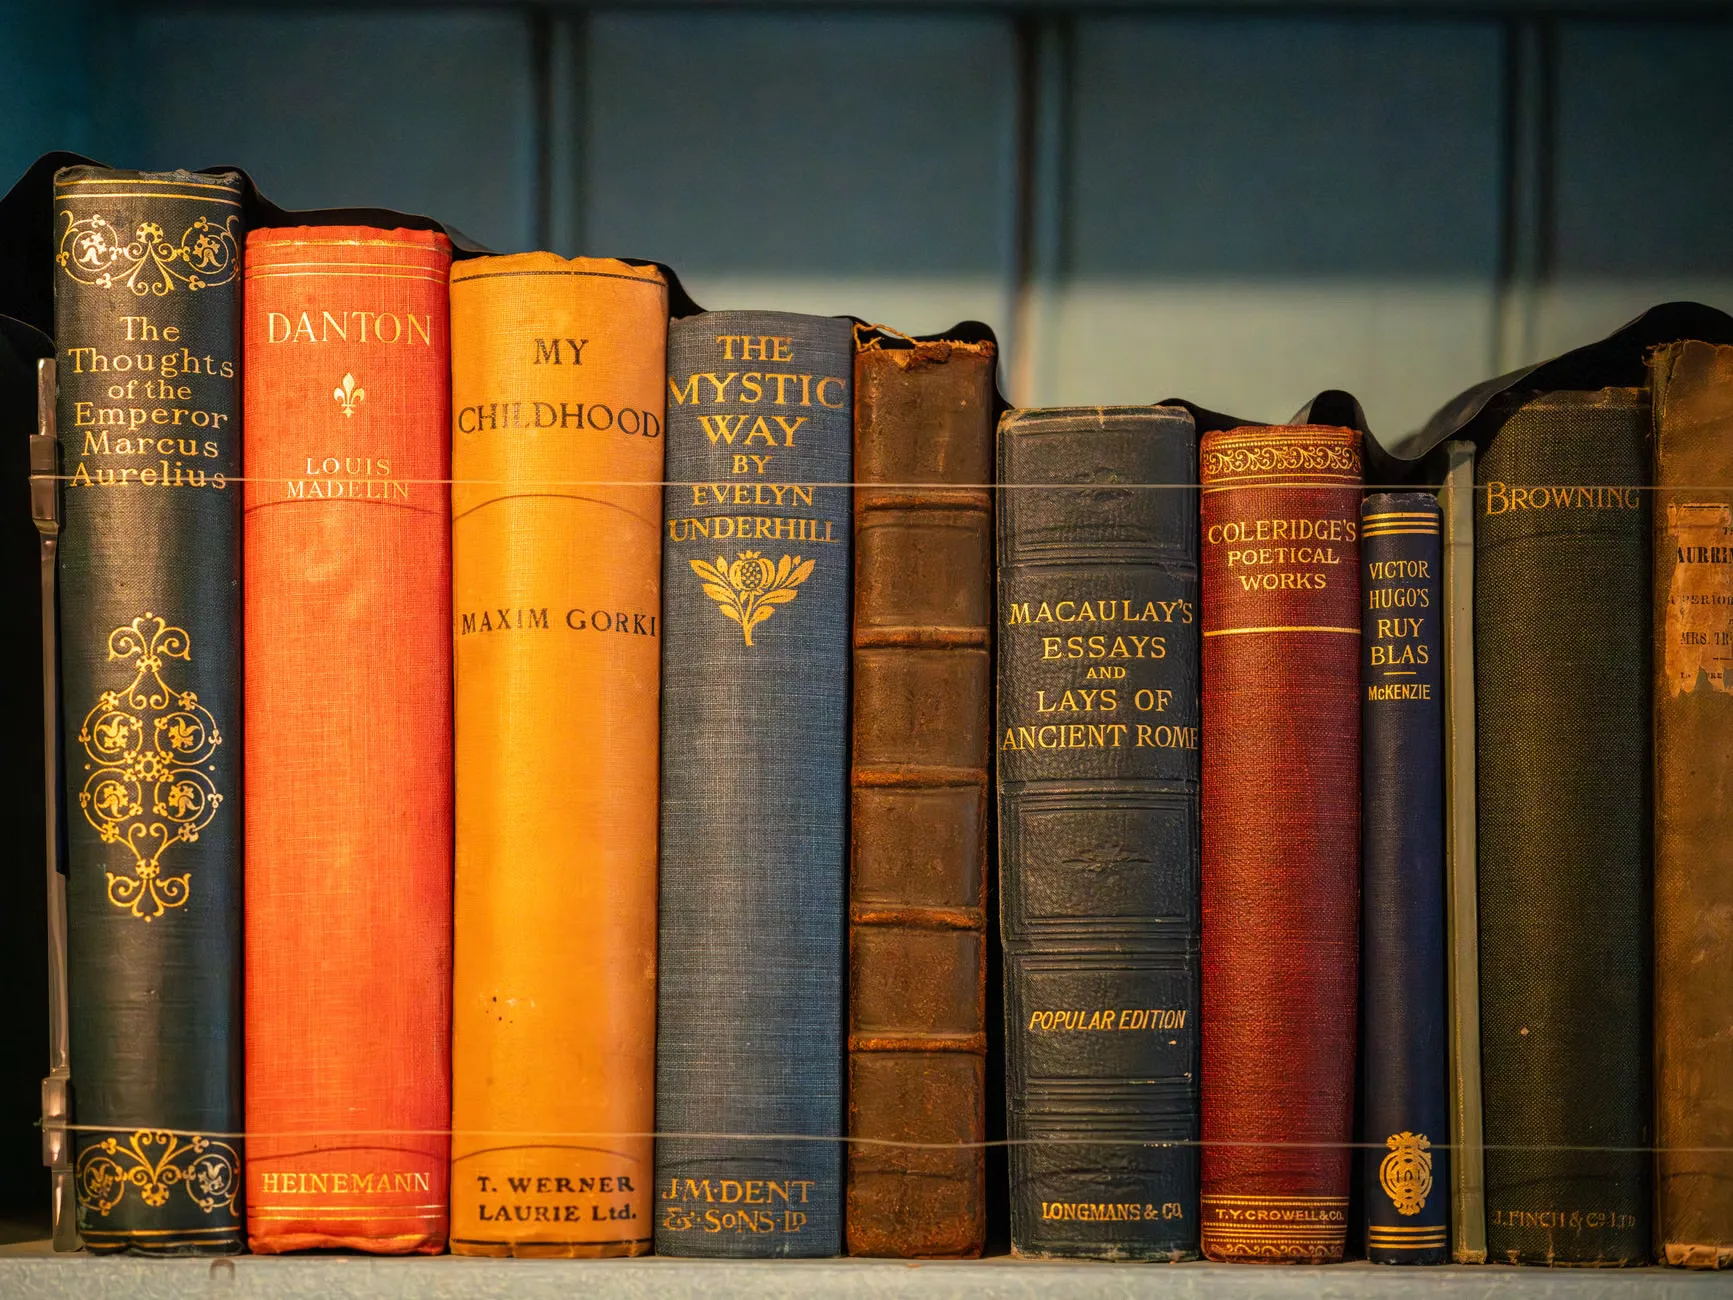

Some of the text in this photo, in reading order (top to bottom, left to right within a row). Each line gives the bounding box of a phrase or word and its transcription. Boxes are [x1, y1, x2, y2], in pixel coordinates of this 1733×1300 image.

[120, 316, 180, 342] The
[267, 311, 432, 346] DANTON
[533, 338, 589, 366] MY
[716, 336, 793, 362] THE
[68, 348, 234, 378] Thoughts
[108, 380, 192, 400] of the
[667, 371, 847, 408] MYSTIC
[74, 402, 228, 430] Emperor
[458, 402, 660, 438] CHILDHOOD
[696, 415, 808, 447] WAY
[82, 430, 219, 458] Marcus
[70, 460, 227, 489] Aurelius
[306, 458, 391, 475] LOUIS
[732, 454, 773, 474] BY
[287, 480, 409, 500] MADELIN
[692, 484, 816, 506] EVELYN
[1486, 481, 1640, 516] BROWNING
[668, 516, 839, 543] UNDERHILL
[1208, 518, 1357, 544] COLERIDGE'S
[1228, 548, 1340, 566] POETICAL
[1368, 560, 1430, 580] VICTOR
[1239, 573, 1327, 591] WORKS
[1368, 588, 1430, 610] HUGO'S
[461, 608, 656, 636] MAXIM GORKI
[1008, 599, 1193, 624] MACAULAY'S
[1377, 618, 1424, 638] RUY
[1041, 636, 1167, 660] ESSAYS
[1370, 645, 1430, 666] BLAS
[1086, 666, 1126, 679] AND
[1035, 689, 1172, 712] LAYS OF
[1368, 684, 1431, 700] McKENZIE
[1001, 724, 1199, 750] ANCIENT ROME
[1029, 1009, 1186, 1030] POPULAR EDITION
[261, 1172, 430, 1194] HEINEMANN
[477, 1176, 635, 1194] T. WERNER
[479, 1204, 638, 1222] LAURIE Ltd.
[1042, 1202, 1142, 1222] LONGMANS
[1144, 1203, 1159, 1220] &
